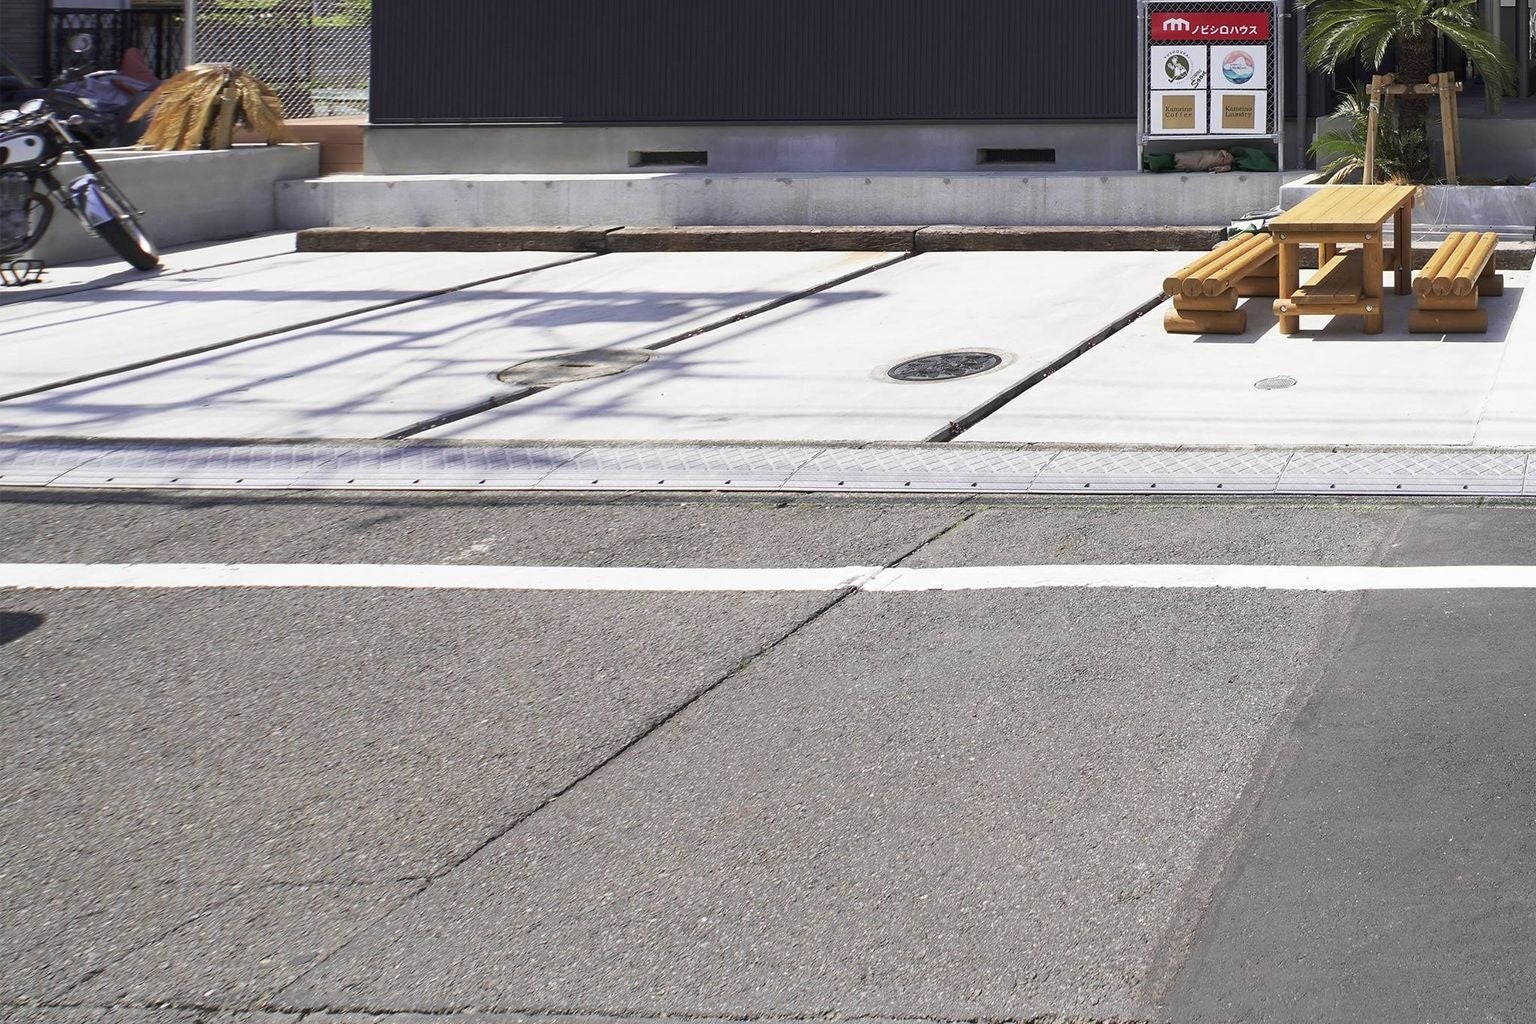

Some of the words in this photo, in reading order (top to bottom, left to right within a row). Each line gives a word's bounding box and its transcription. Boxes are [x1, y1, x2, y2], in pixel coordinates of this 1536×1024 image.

[1192, 25, 1257, 35] ノビシロハウス
